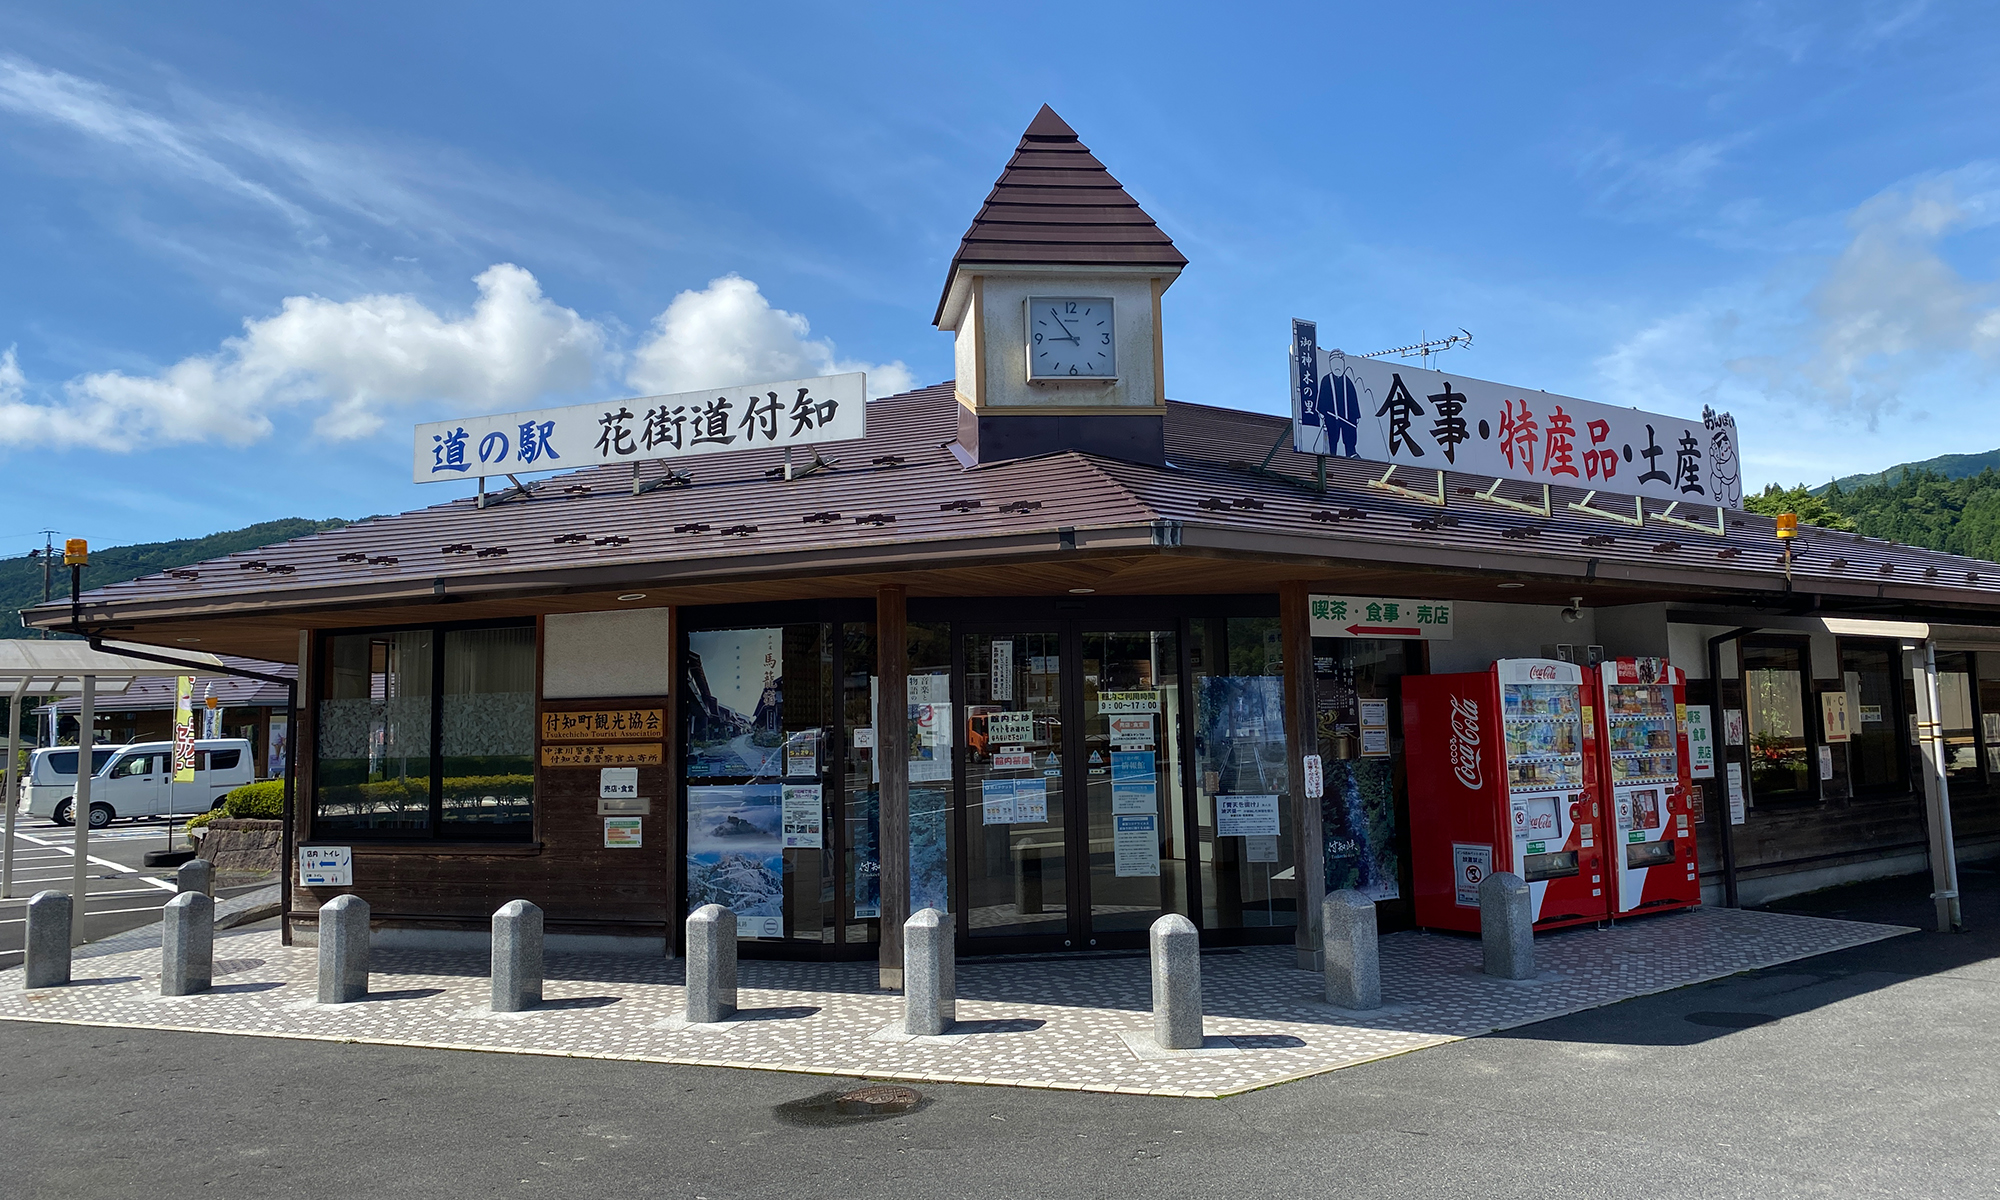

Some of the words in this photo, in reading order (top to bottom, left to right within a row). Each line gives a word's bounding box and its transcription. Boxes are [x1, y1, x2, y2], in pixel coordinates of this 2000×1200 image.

[1065, 301, 1077, 314] 12
[1034, 332, 1044, 345] 9
[1101, 332, 1110, 345] 3
[1069, 364, 1078, 376] 6
[1300, 336, 1315, 415] 御神木の里
[431, 419, 561, 474] 道の駅
[594, 387, 840, 458] 花街道付知
[909, 676, 918, 701] 物語の
[921, 676, 930, 701] 音楽と
[1101, 692, 1156, 701] 館内ご利用時間
[545, 711, 660, 731] 付知町観光協会
[990, 713, 1030, 723] 館内には
[1687, 711, 1701, 724] 喫茶
[591, 730, 617, 738] Tourist
[620, 730, 661, 738] Association
[1692, 728, 1707, 741] 食事
[544, 746, 606, 755] 中津川警察署
[1697, 746, 1712, 759] 売店
[550, 753, 658, 764] 付知交番警察官立寄所
[994, 756, 1030, 766] 館内禁煙
[1121, 761, 1146, 770] 情報館
[603, 784, 635, 793] 売店・食堂
[1328, 839, 1358, 853] 付知峡
[306, 850, 318, 858] 店内
[323, 850, 340, 858] トイレ
[1462, 856, 1483, 864] 設置禁止
